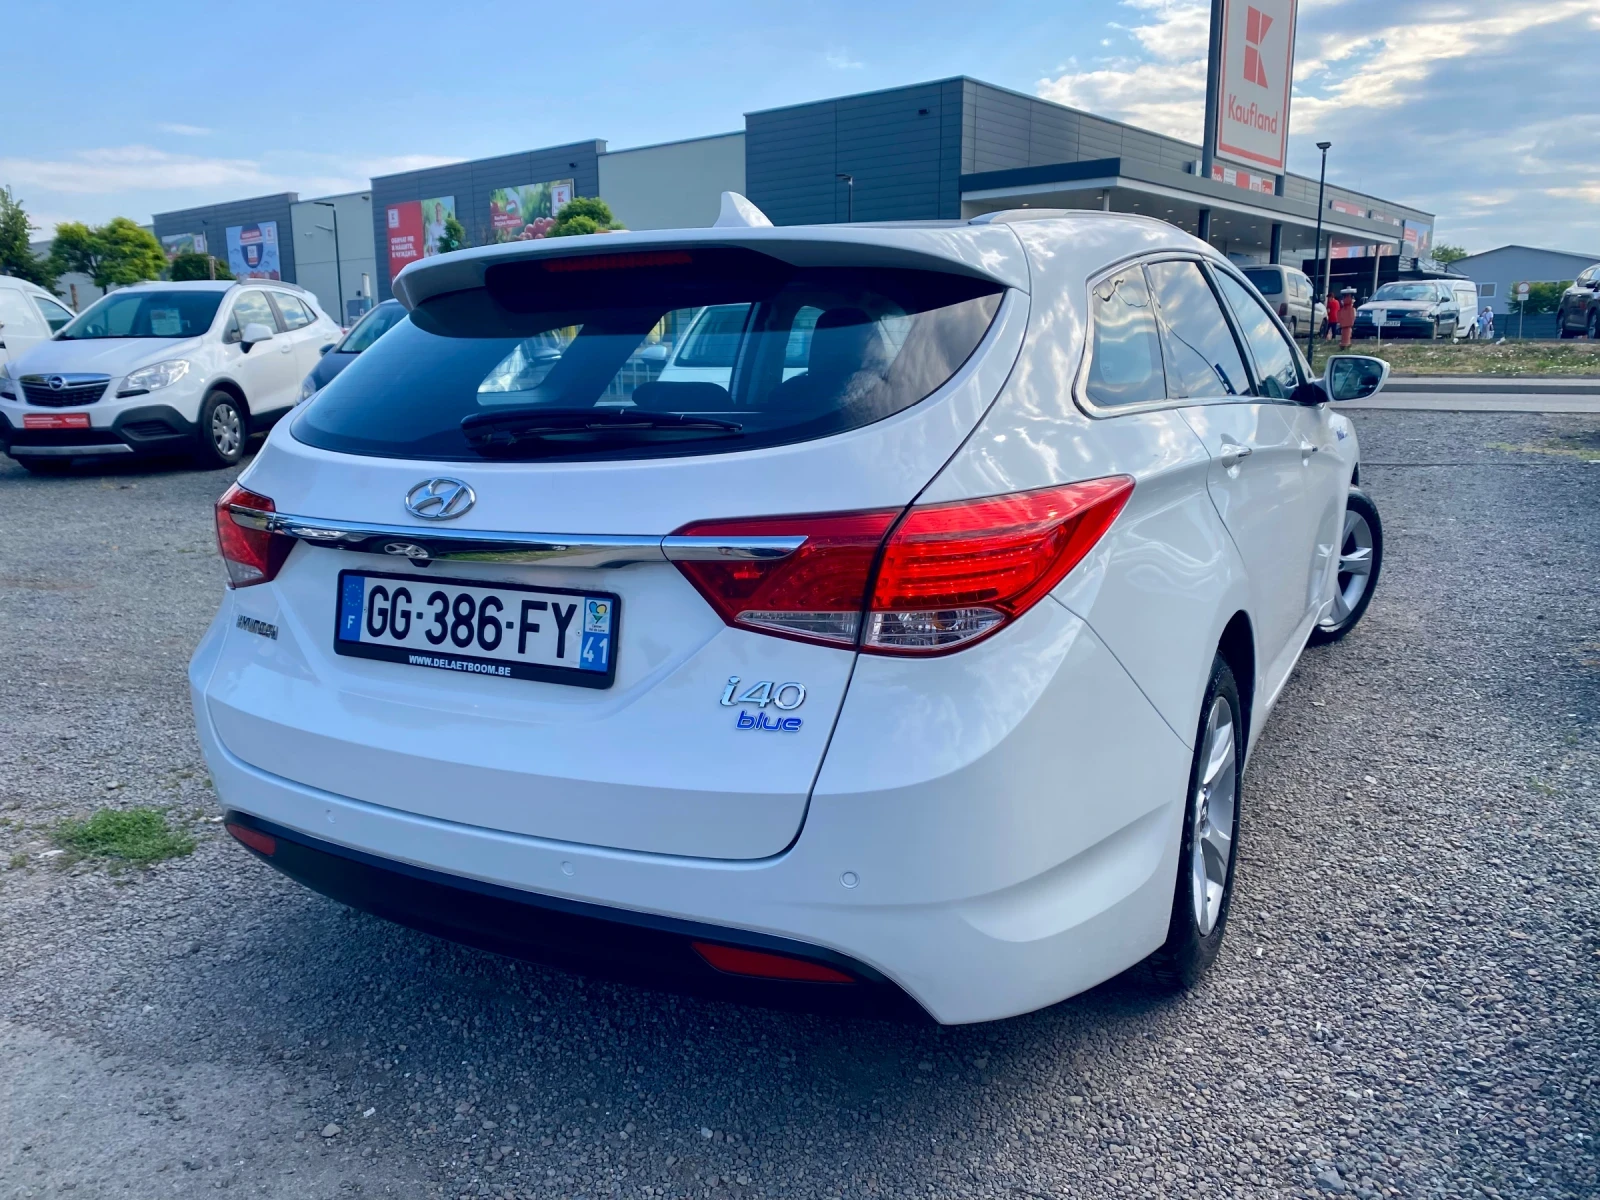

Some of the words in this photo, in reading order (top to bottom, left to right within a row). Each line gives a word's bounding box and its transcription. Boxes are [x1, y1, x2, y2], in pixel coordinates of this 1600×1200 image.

[1228, 93, 1278, 134] Kaufland
[347, 615, 355, 629] F
[583, 636, 608, 664] 41
[408, 654, 512, 677] WWW.DELAETBOOM.BE
[720, 675, 807, 710] i40
[736, 710, 803, 732] blue
